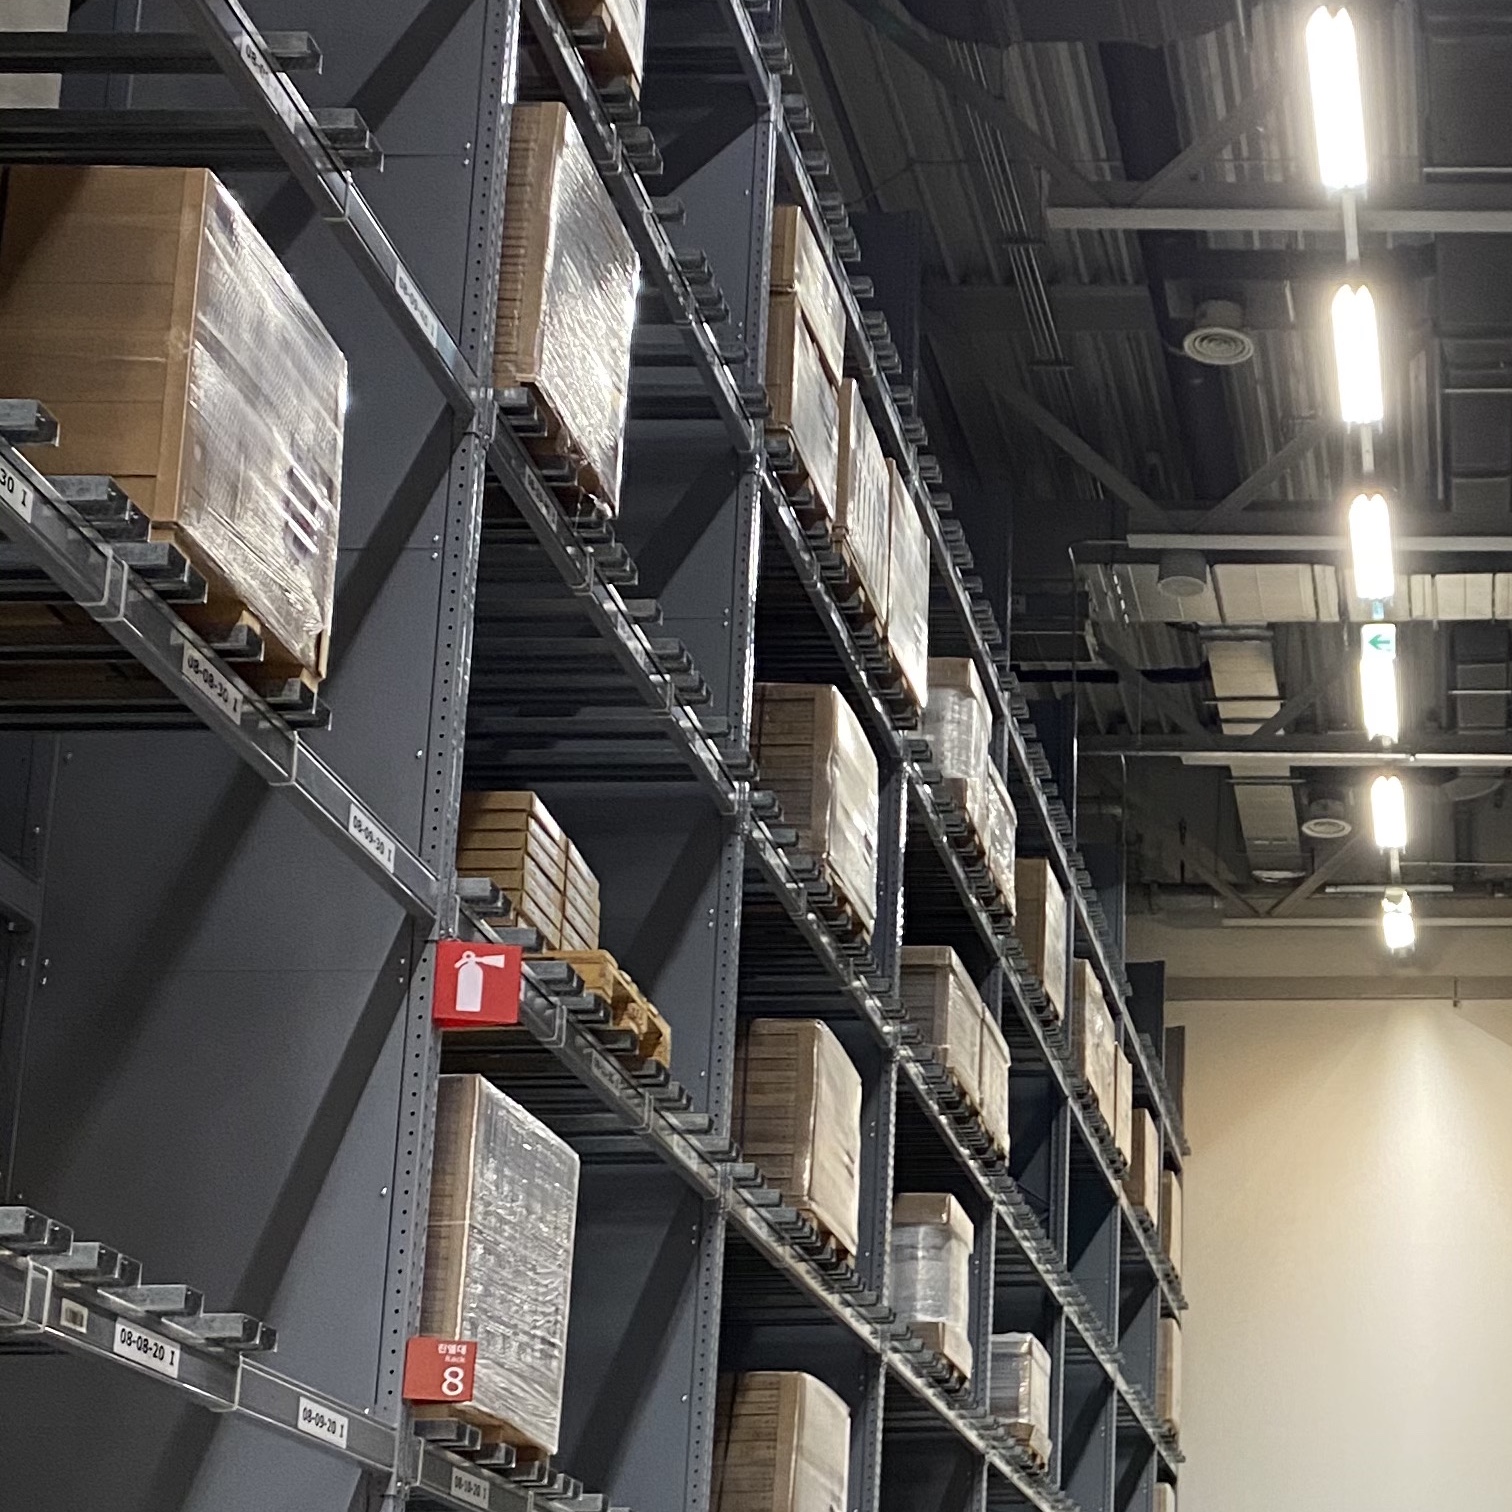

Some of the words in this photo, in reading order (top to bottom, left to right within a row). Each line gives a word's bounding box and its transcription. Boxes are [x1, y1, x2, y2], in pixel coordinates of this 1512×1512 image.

[120, 1327, 165, 1362] 08-08-20
[169, 1350, 175, 1366] I
[441, 1366, 465, 1396] 8
[302, 1406, 336, 1435] 08-09-20
